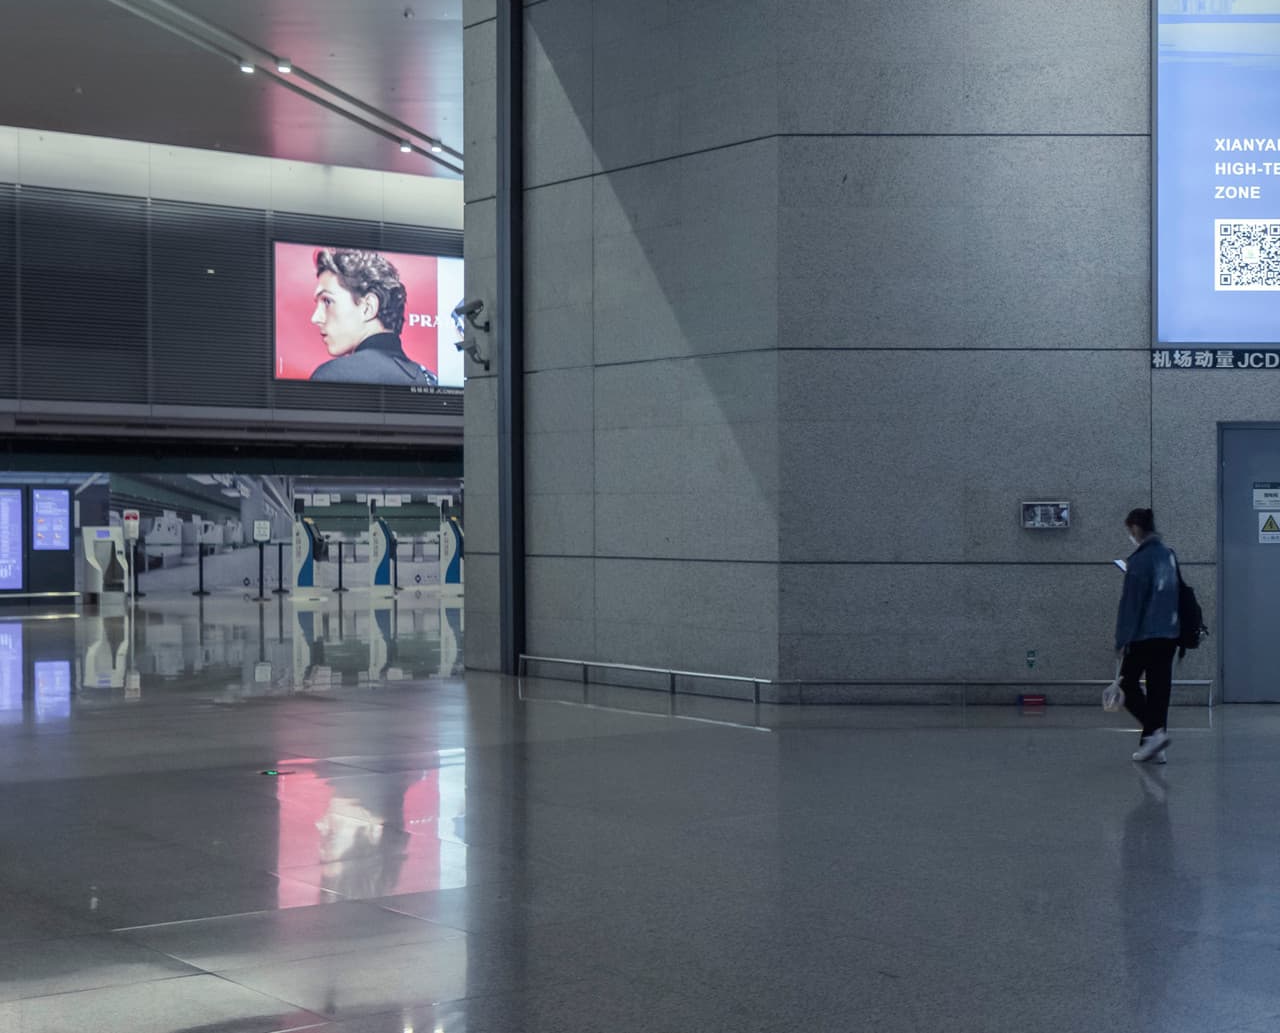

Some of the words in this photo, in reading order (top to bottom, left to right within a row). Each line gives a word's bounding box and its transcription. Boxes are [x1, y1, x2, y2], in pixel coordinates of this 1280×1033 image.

[1214, 186, 1261, 199] ZONE
[1152, 350, 1234, 368] 机场动量
